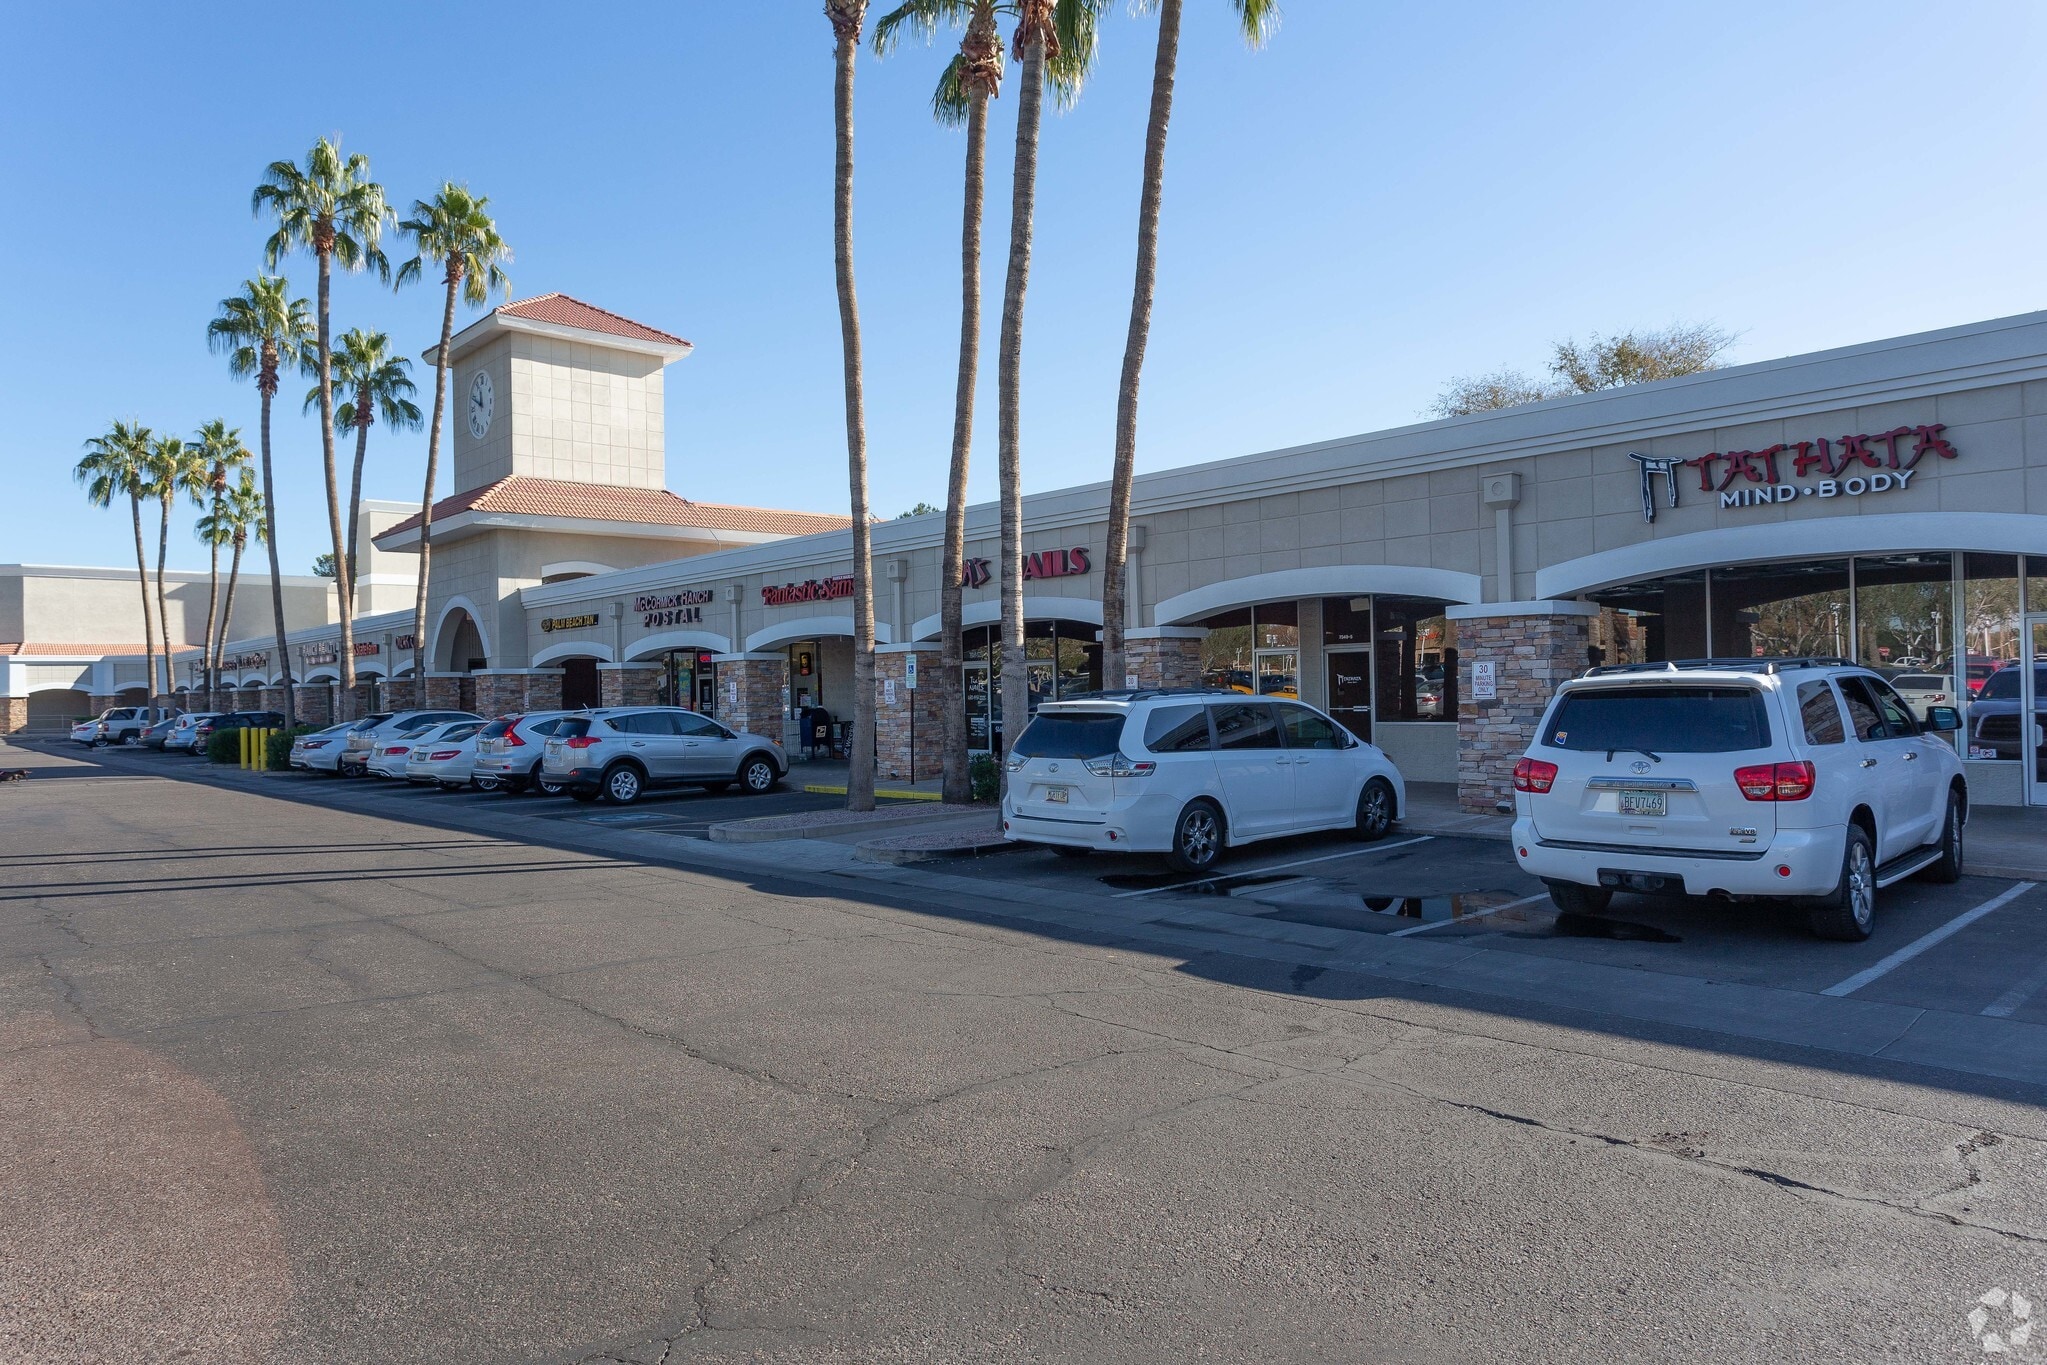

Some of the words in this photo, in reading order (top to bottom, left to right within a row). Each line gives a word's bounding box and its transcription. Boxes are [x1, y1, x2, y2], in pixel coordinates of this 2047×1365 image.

[1685, 423, 1958, 491] TATHATA
[1021, 546, 1091, 580] AILS
[681, 590, 711, 606] RANCH
[761, 579, 818, 605] Fantastic
[644, 607, 703, 627] POSTAL
[1479, 664, 1489, 674] 30
